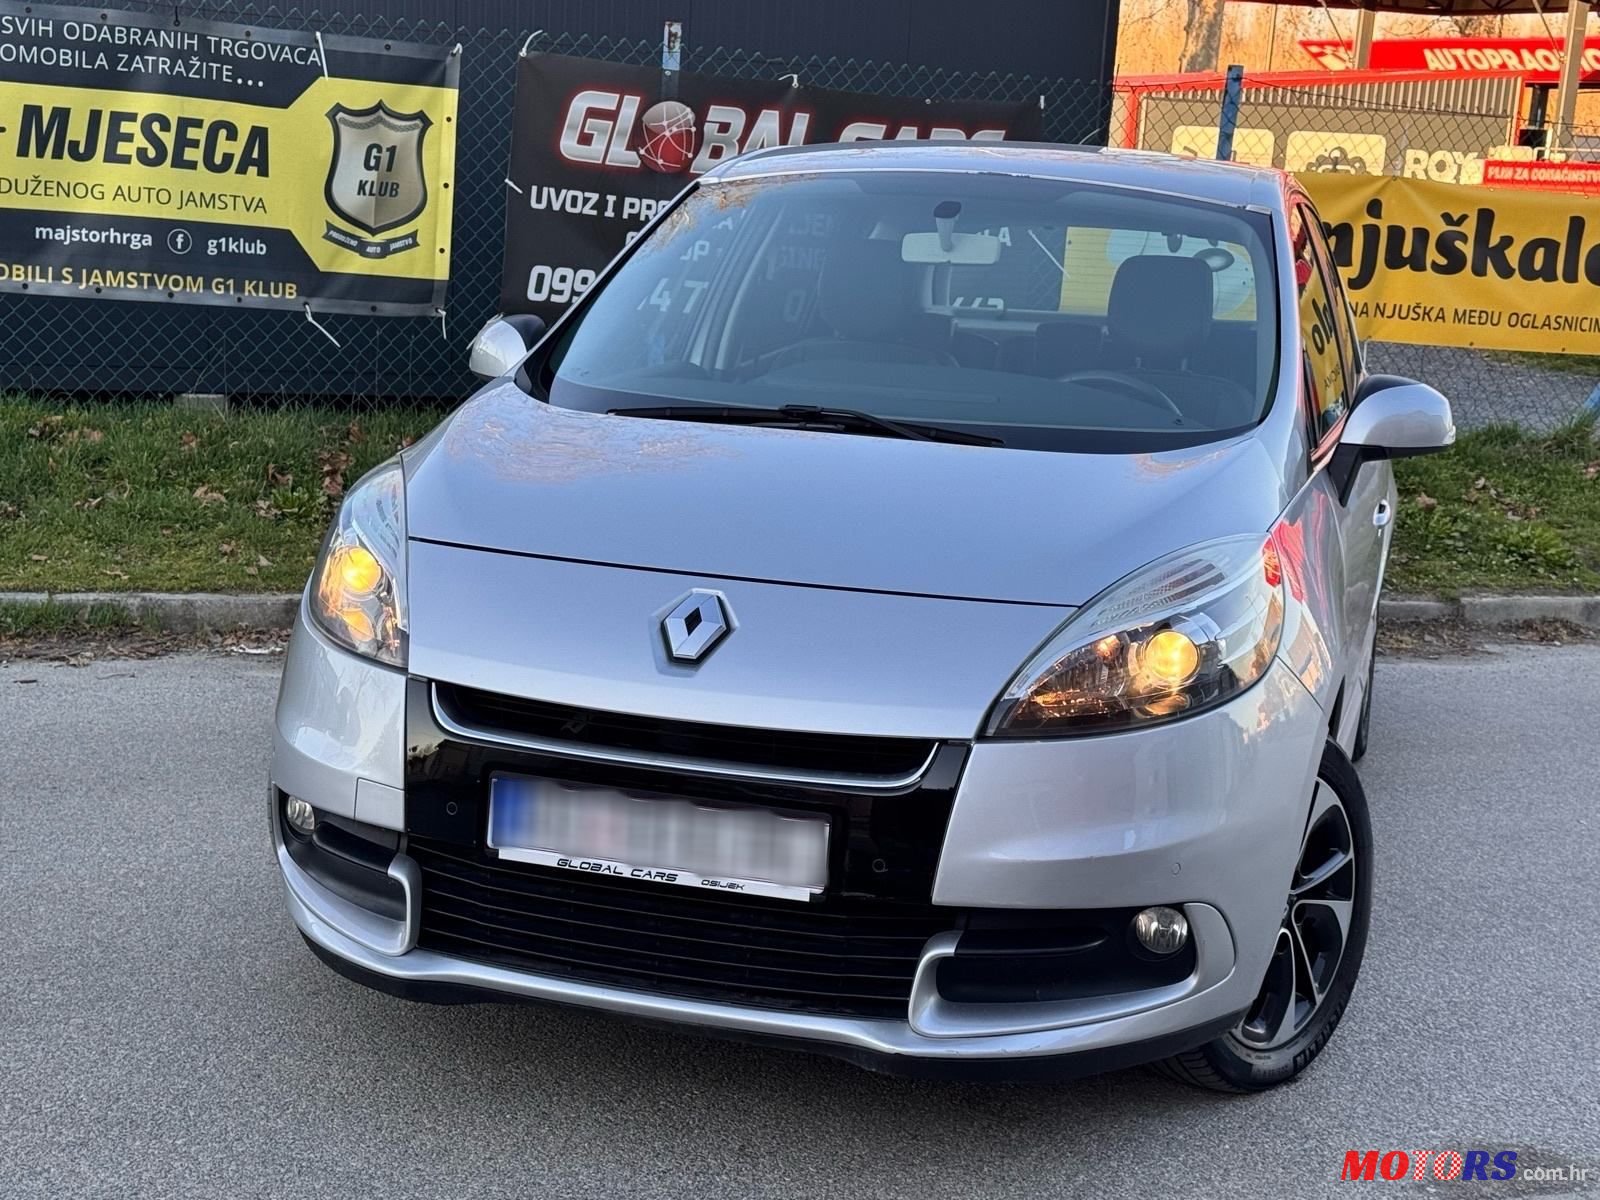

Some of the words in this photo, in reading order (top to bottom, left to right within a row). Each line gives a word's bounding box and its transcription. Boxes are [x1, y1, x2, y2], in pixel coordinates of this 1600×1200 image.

[1, 15, 53, 38] SVIH
[63, 21, 198, 51] ODABRANIH
[206, 36, 322, 66] TRGOVACA
[0, 43, 109, 70] OMOBILA
[16, 104, 270, 178] MJESECA
[363, 143, 397, 172] G1
[112, 185, 172, 205] AUTO
[177, 189, 267, 214] JAMSTVA
[357, 180, 400, 197] KLUB
[530, 185, 599, 216] UVOZ
[604, 195, 617, 217] I
[35, 225, 153, 250] majstorhrga
[207, 237, 267, 255] g1klub
[61, 267, 73, 284] S
[79, 268, 204, 293] JAMSTVOM
[211, 277, 235, 296] G1
[244, 280, 297, 299] KLUB
[1373, 301, 1446, 323] NJUŠKA
[1452, 308, 1502, 327] MEĐU
[556, 857, 624, 876] GLOBAL
[630, 867, 679, 882] CARS
